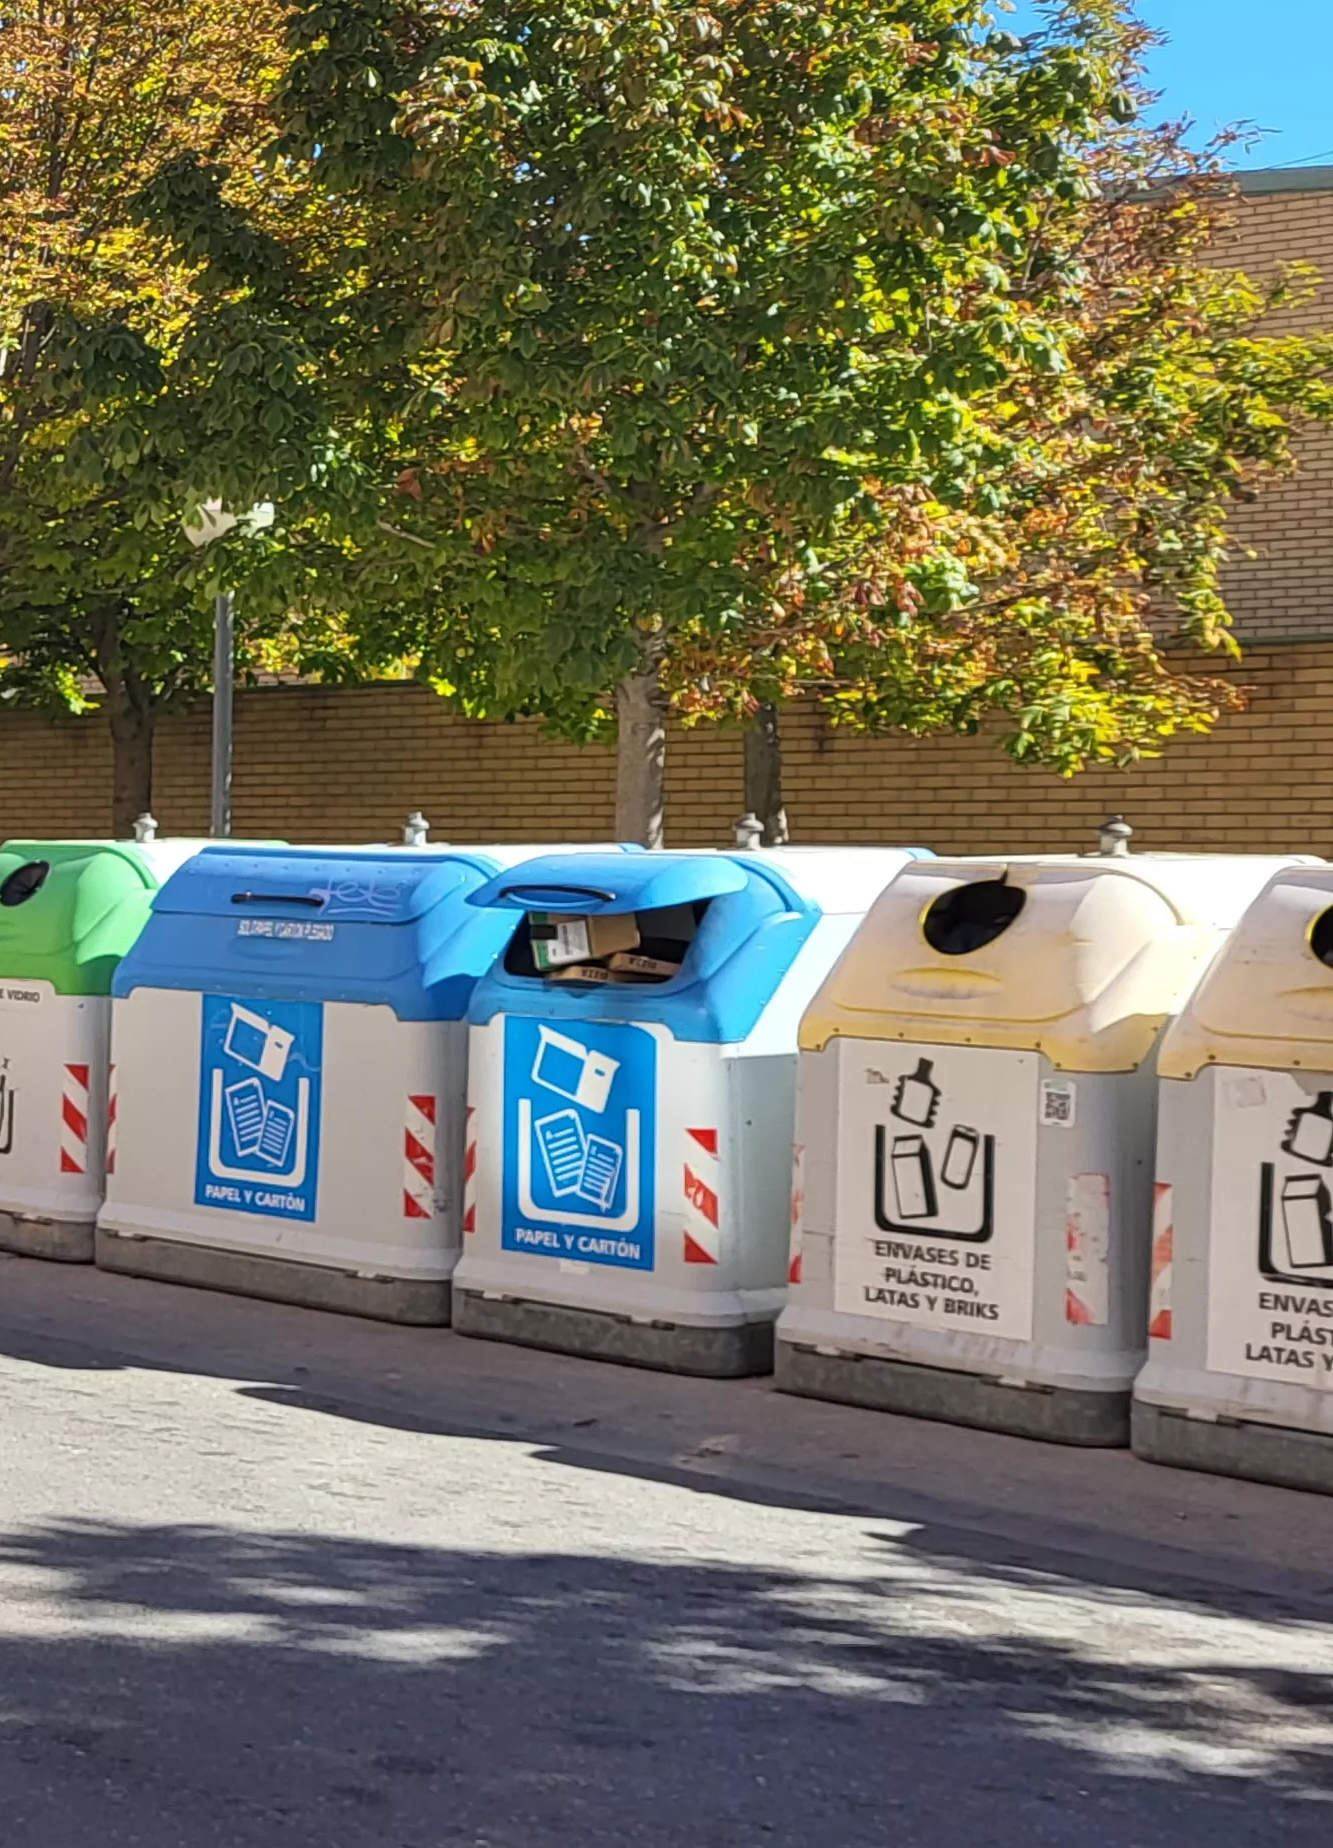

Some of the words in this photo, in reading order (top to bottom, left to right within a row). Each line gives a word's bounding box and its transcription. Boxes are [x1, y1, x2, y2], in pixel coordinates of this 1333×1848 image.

[7, 989, 40, 1003] VIDRIO
[205, 1184, 241, 1203] PAPEL
[243, 1189, 253, 1204] Y
[255, 1191, 305, 1212] CARTÓN
[514, 1227, 561, 1248] PAPEL
[563, 1234, 574, 1250] Y
[577, 1236, 640, 1260] CARTÓN
[874, 1239, 959, 1266] ENVASES
[965, 1252, 992, 1271] DE
[884, 1264, 979, 1297] PLÁSTICO,
[864, 1286, 920, 1309] LATAS
[924, 1294, 938, 1311] Y
[943, 1297, 999, 1320] BRIKS
[1245, 1342, 1314, 1368] LATAS
